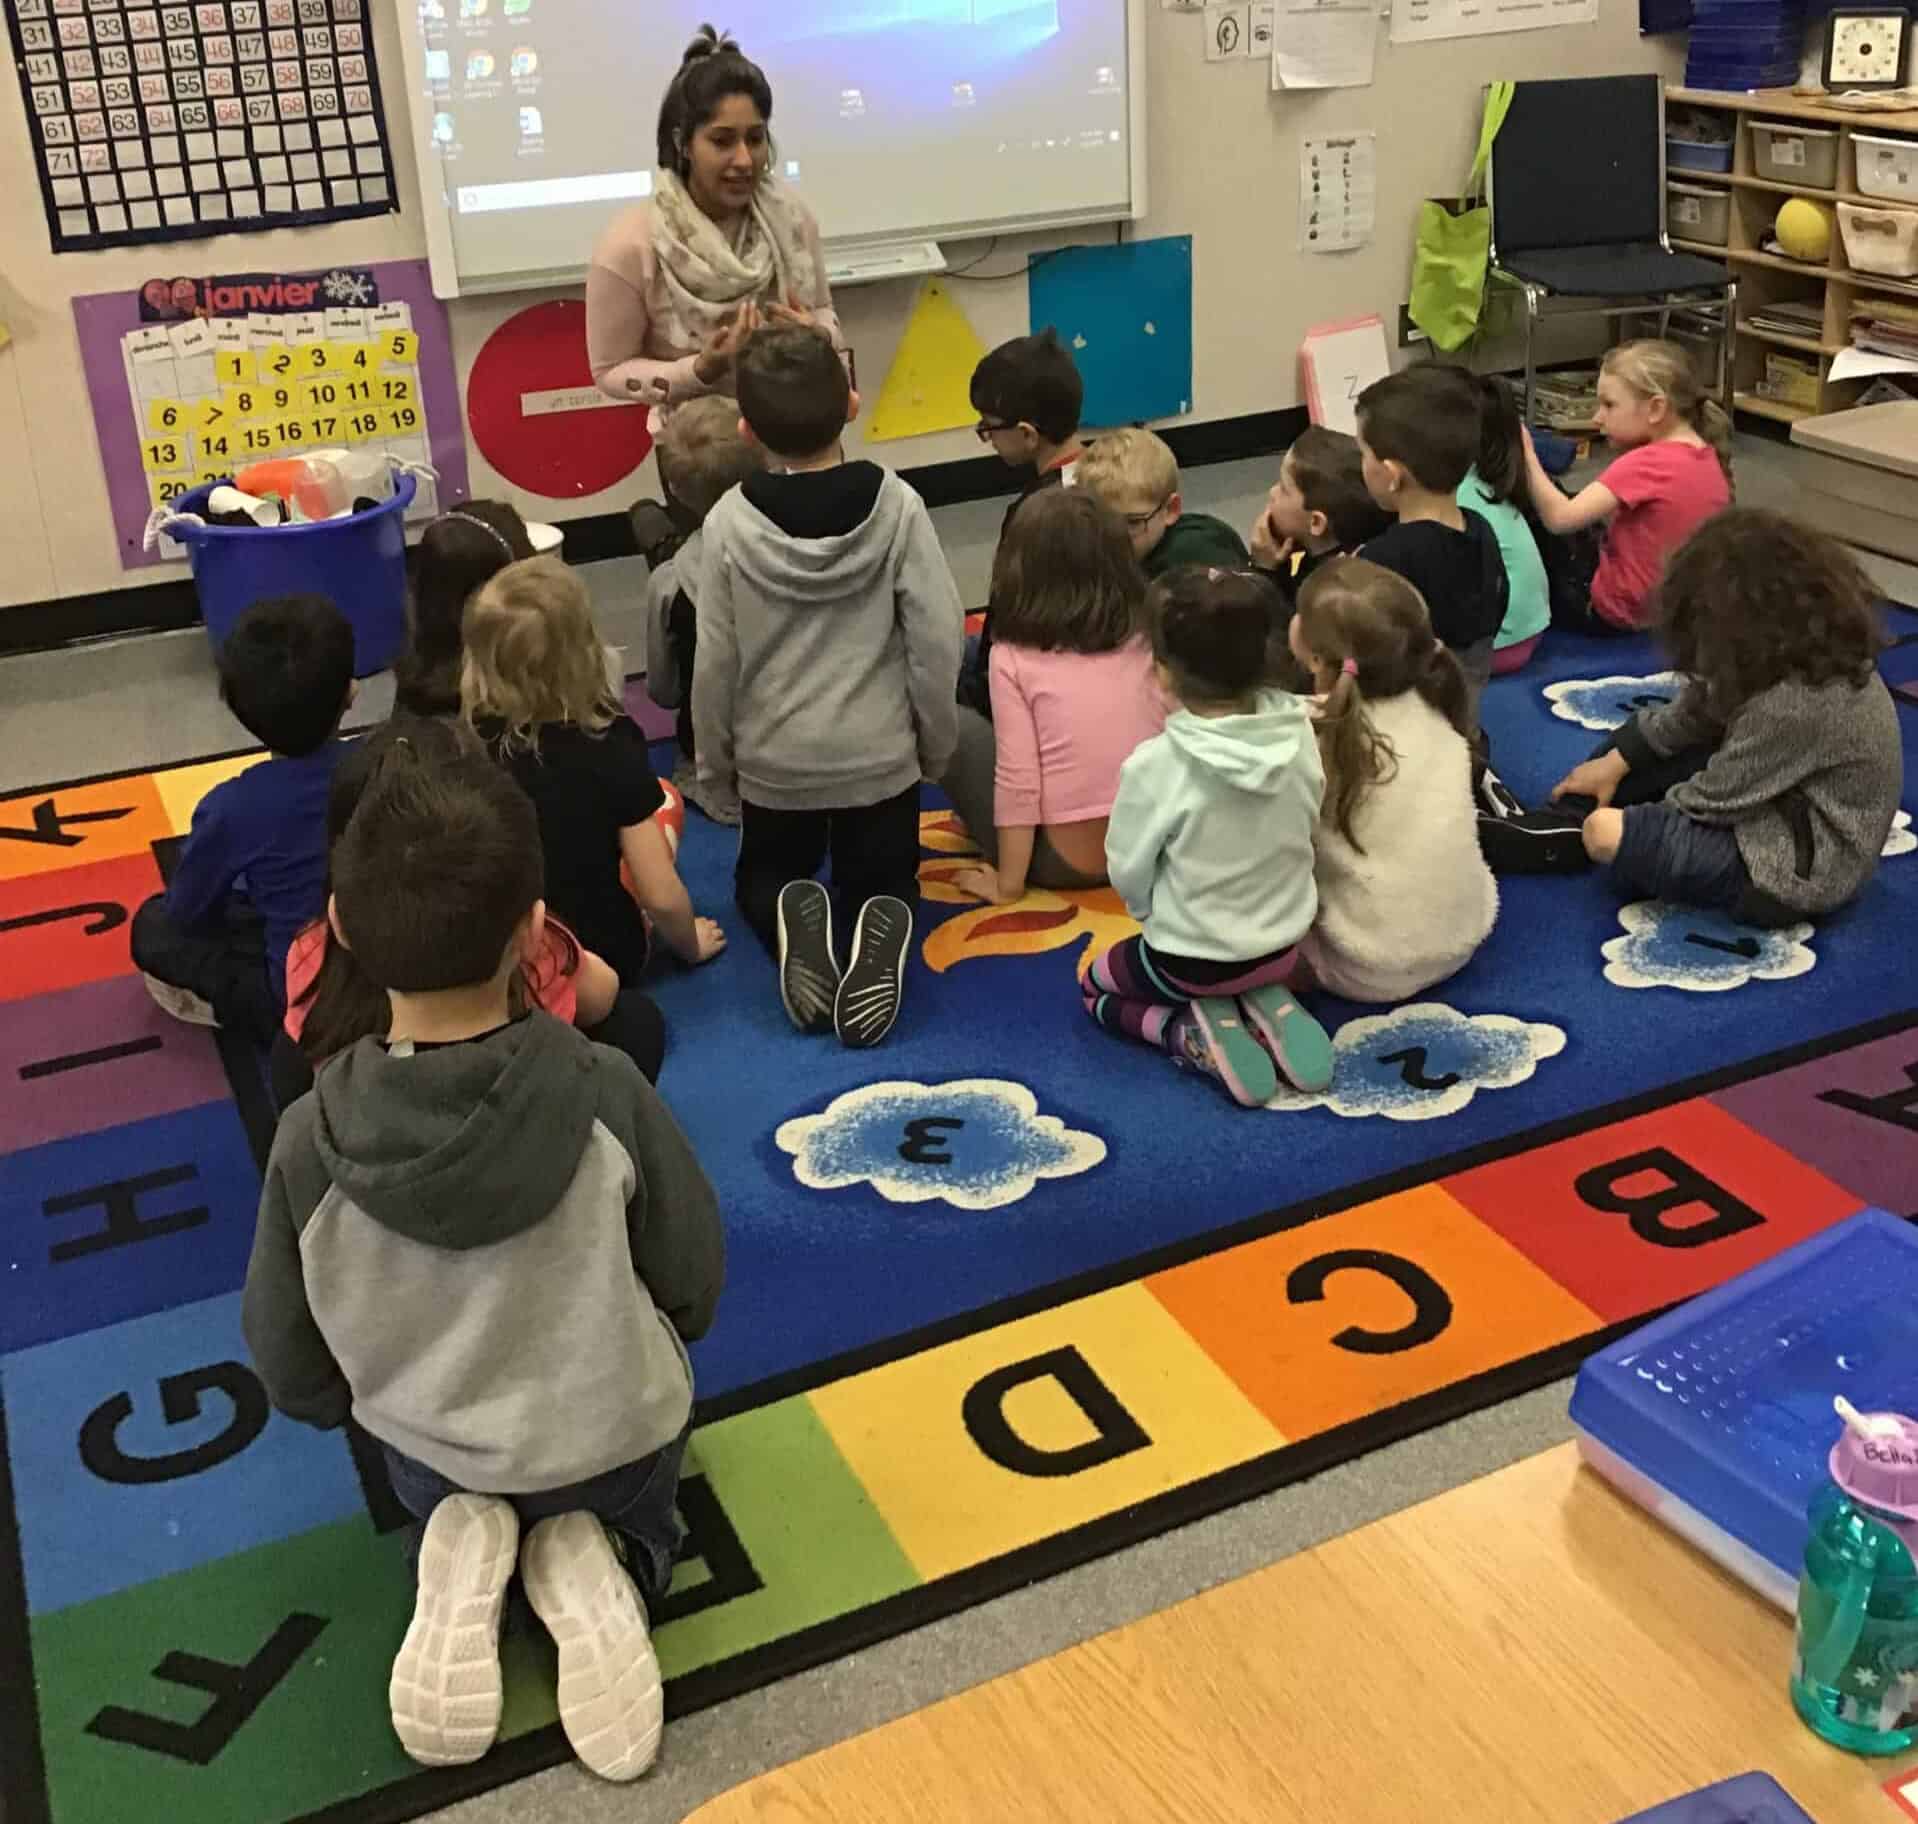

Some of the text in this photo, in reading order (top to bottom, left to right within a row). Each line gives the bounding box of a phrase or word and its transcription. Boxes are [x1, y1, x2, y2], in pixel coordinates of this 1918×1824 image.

[24, 27, 47, 44] 31
[62, 23, 85, 41] 32
[96, 19, 121, 37] 33
[132, 15, 155, 34] 34
[165, 12, 191, 31] 35
[200, 10, 223, 26] 36
[234, 6, 257, 24] 37
[271, 3, 290, 21] 38
[301, 0, 324, 18] 39
[28, 29, 360, 75] 41 42 43 44 45 46 47 48 49 50
[35, 60, 364, 109] 51 52 53 54 55 56 57 58 59 60
[45, 90, 369, 139] 61 62 63 64 65 66 67 68 69 70
[49, 149, 106, 170] 71 72
[203, 276, 320, 317] janvier
[232, 336, 406, 376] 1 2 3 4 5
[162, 381, 407, 426] 6 7 8 9 10 11 12
[149, 408, 416, 463] 13 14 15 16 17 18 19
[160, 483, 187, 501] 20
[0, 902, 128, 937] J
[18, 1035, 163, 1081] I
[1376, 1045, 1462, 1091] 2
[897, 1116, 964, 1165] 3
[42, 1163, 210, 1264] H
[1574, 1146, 1767, 1248] B
[1286, 1248, 1453, 1354] C
[77, 1360, 270, 1485] G
[962, 1344, 1153, 1477] D
[84, 1611, 330, 1765] F
